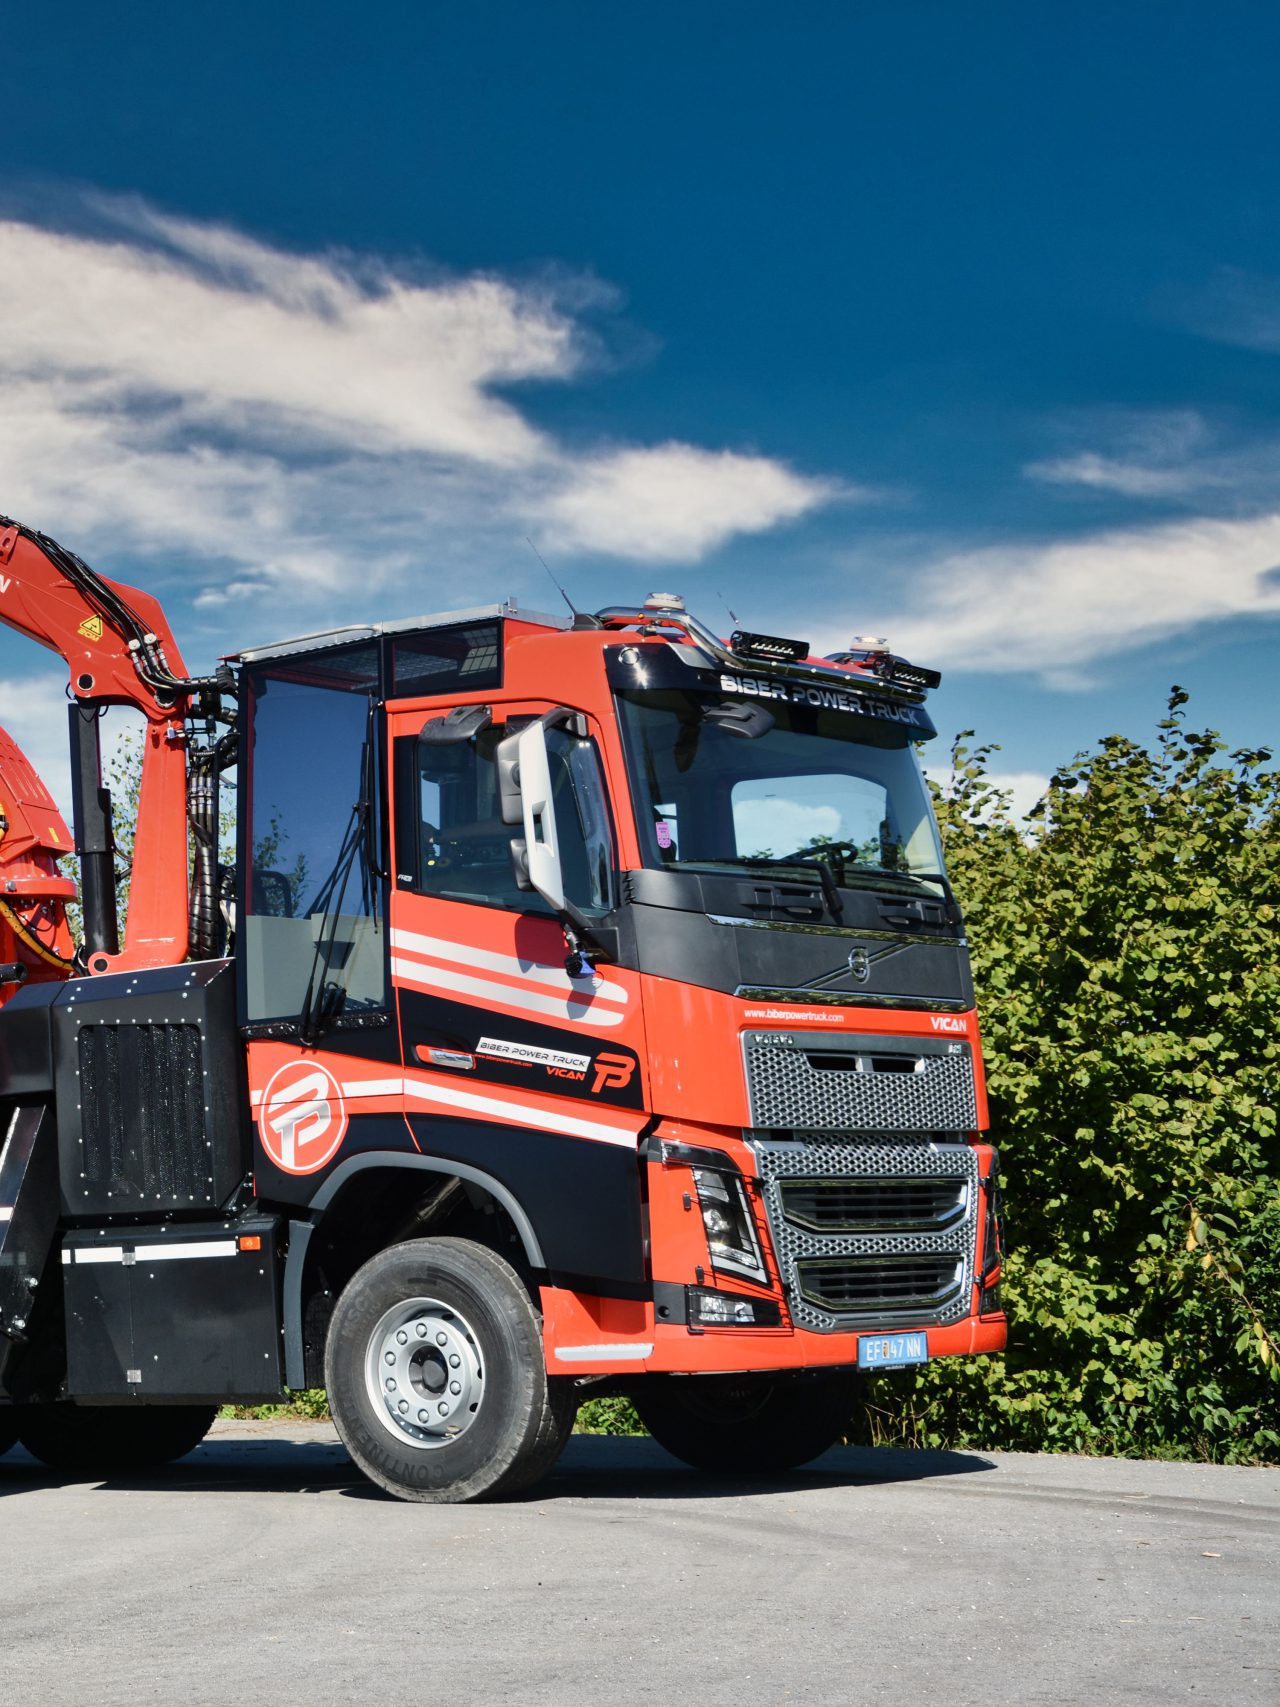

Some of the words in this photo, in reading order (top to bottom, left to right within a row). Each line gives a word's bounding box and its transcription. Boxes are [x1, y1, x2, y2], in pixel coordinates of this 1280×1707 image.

[720, 674, 789, 700] BIBER
[793, 687, 864, 713] POWER
[865, 700, 921, 725] TRUCK
[744, 1008, 845, 1022] www.biberpowertruck.com
[930, 1016, 967, 1032] VICAN
[480, 1042, 510, 1053] BIBER
[512, 1047, 550, 1060] POWER
[553, 1055, 587, 1067] TRUCK
[545, 1066, 587, 1081] VICAN
[866, 1341, 880, 1362] EF
